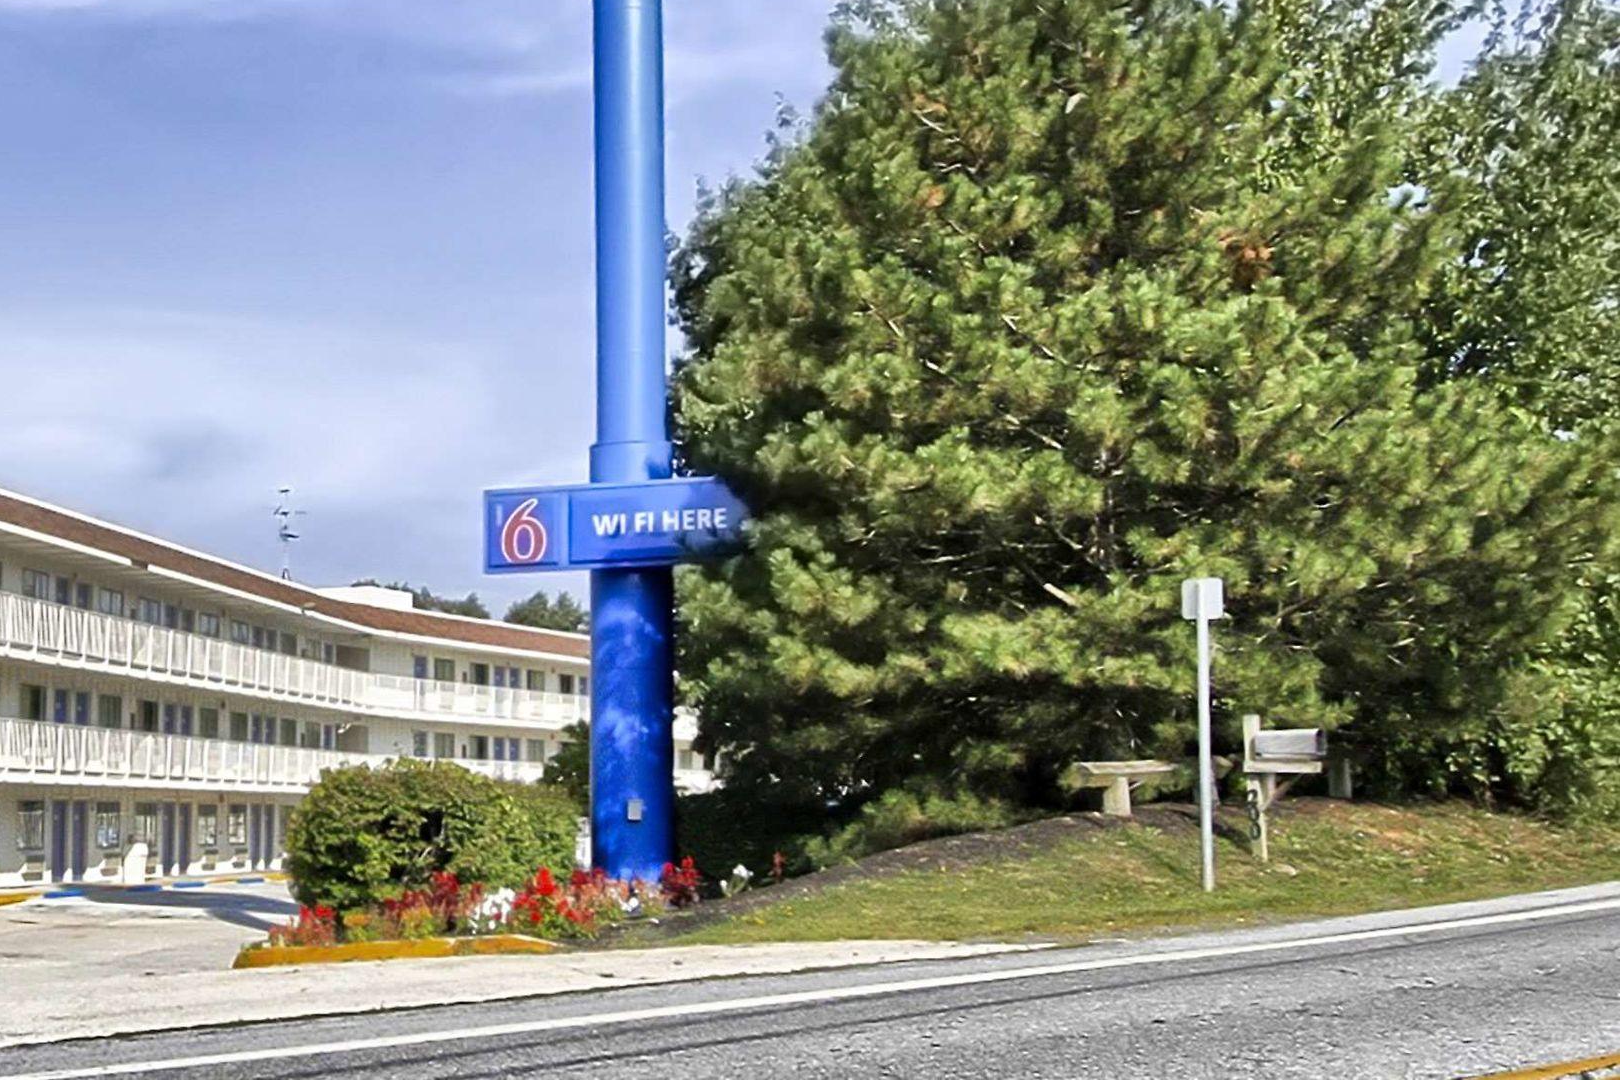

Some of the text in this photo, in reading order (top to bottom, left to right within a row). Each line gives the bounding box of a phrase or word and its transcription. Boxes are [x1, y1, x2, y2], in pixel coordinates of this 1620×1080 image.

[501, 498, 547, 563] 6
[592, 507, 728, 536] WI FI HERE
